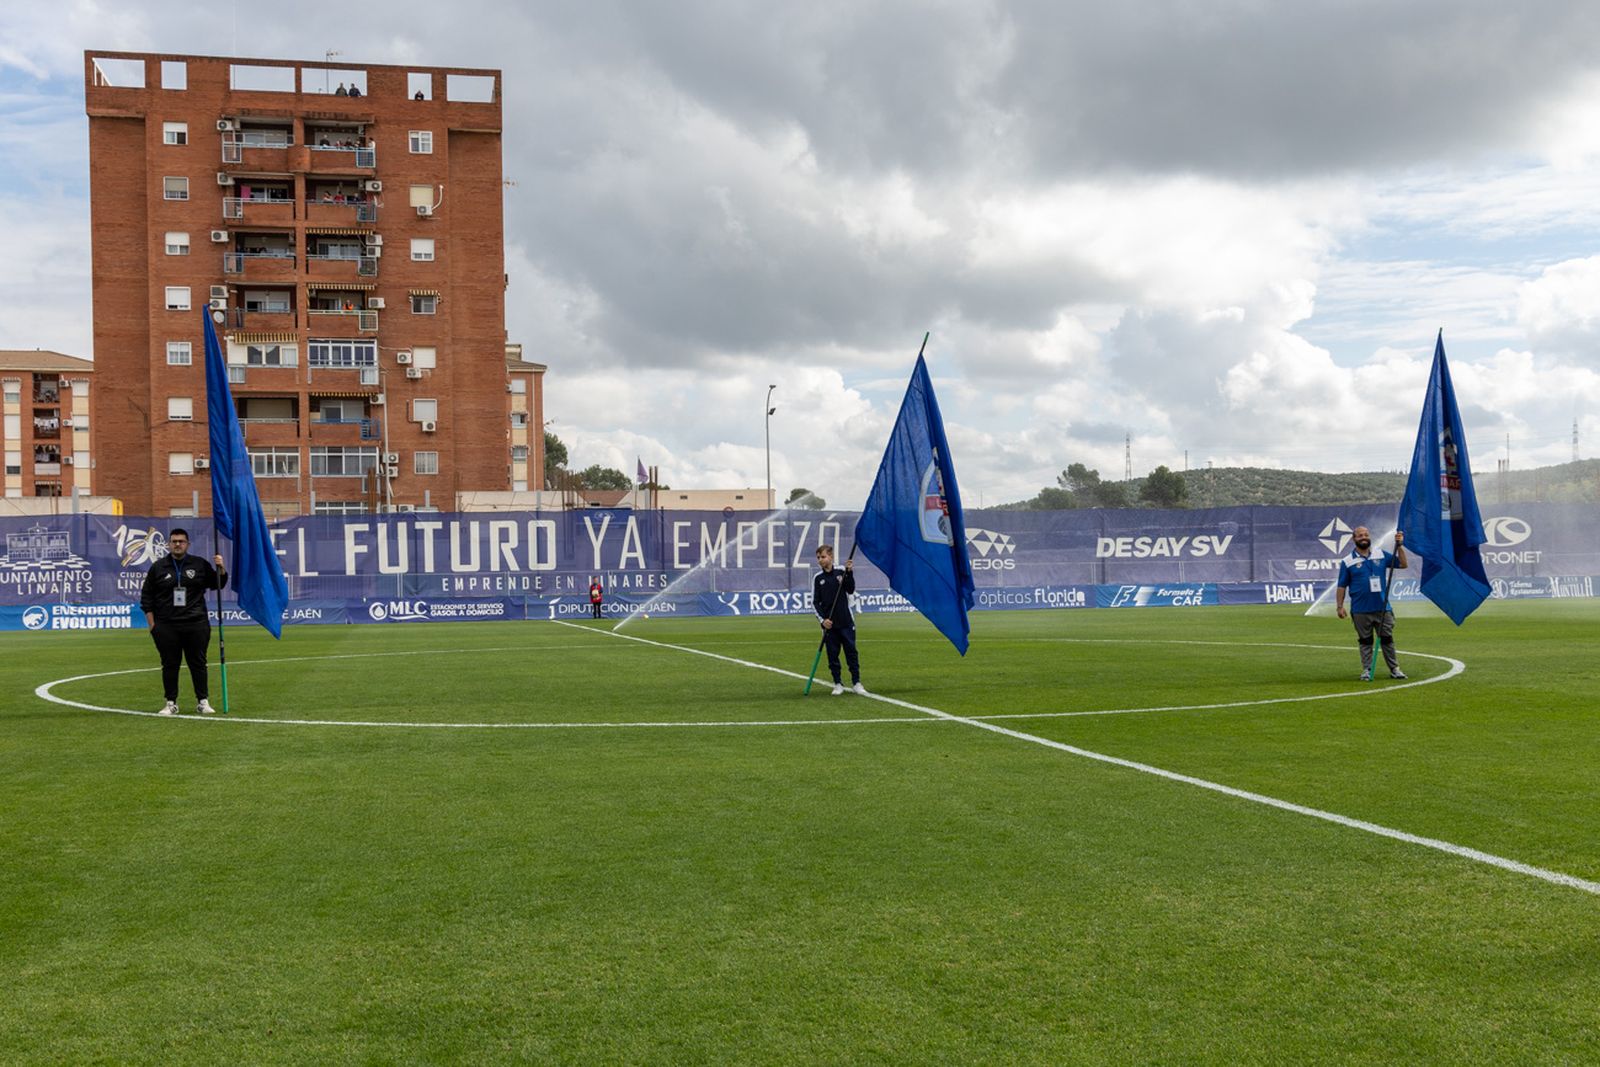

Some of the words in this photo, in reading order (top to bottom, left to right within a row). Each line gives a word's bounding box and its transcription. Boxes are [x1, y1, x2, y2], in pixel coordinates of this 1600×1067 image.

[270, 528, 319, 577] EL
[344, 519, 557, 576] FUTURO
[583, 515, 646, 570] YA
[673, 513, 840, 569] EMPEZÓ
[1096, 536, 1189, 558] DESAY
[1190, 535, 1234, 557] SV
[969, 558, 1016, 570] EJOS
[1295, 559, 1341, 570] SANT
[17, 582, 93, 595] LINARES
[442, 576, 542, 592] EMPRENDE
[555, 575, 576, 590] EN
[1157, 588, 1194, 597] Formula
[1392, 581, 1422, 600] Gale
[979, 591, 1031, 607] ópticas
[1035, 588, 1086, 604] florida
[1172, 597, 1203, 606] CAR
[291, 607, 322, 619] JAÉN
[390, 601, 428, 615] MLC
[430, 609, 458, 617] GASOIL
[559, 602, 629, 614] DIPUTCIÓN
[647, 602, 676, 612] JAÉN
[52, 617, 132, 630] EVOLUTION
